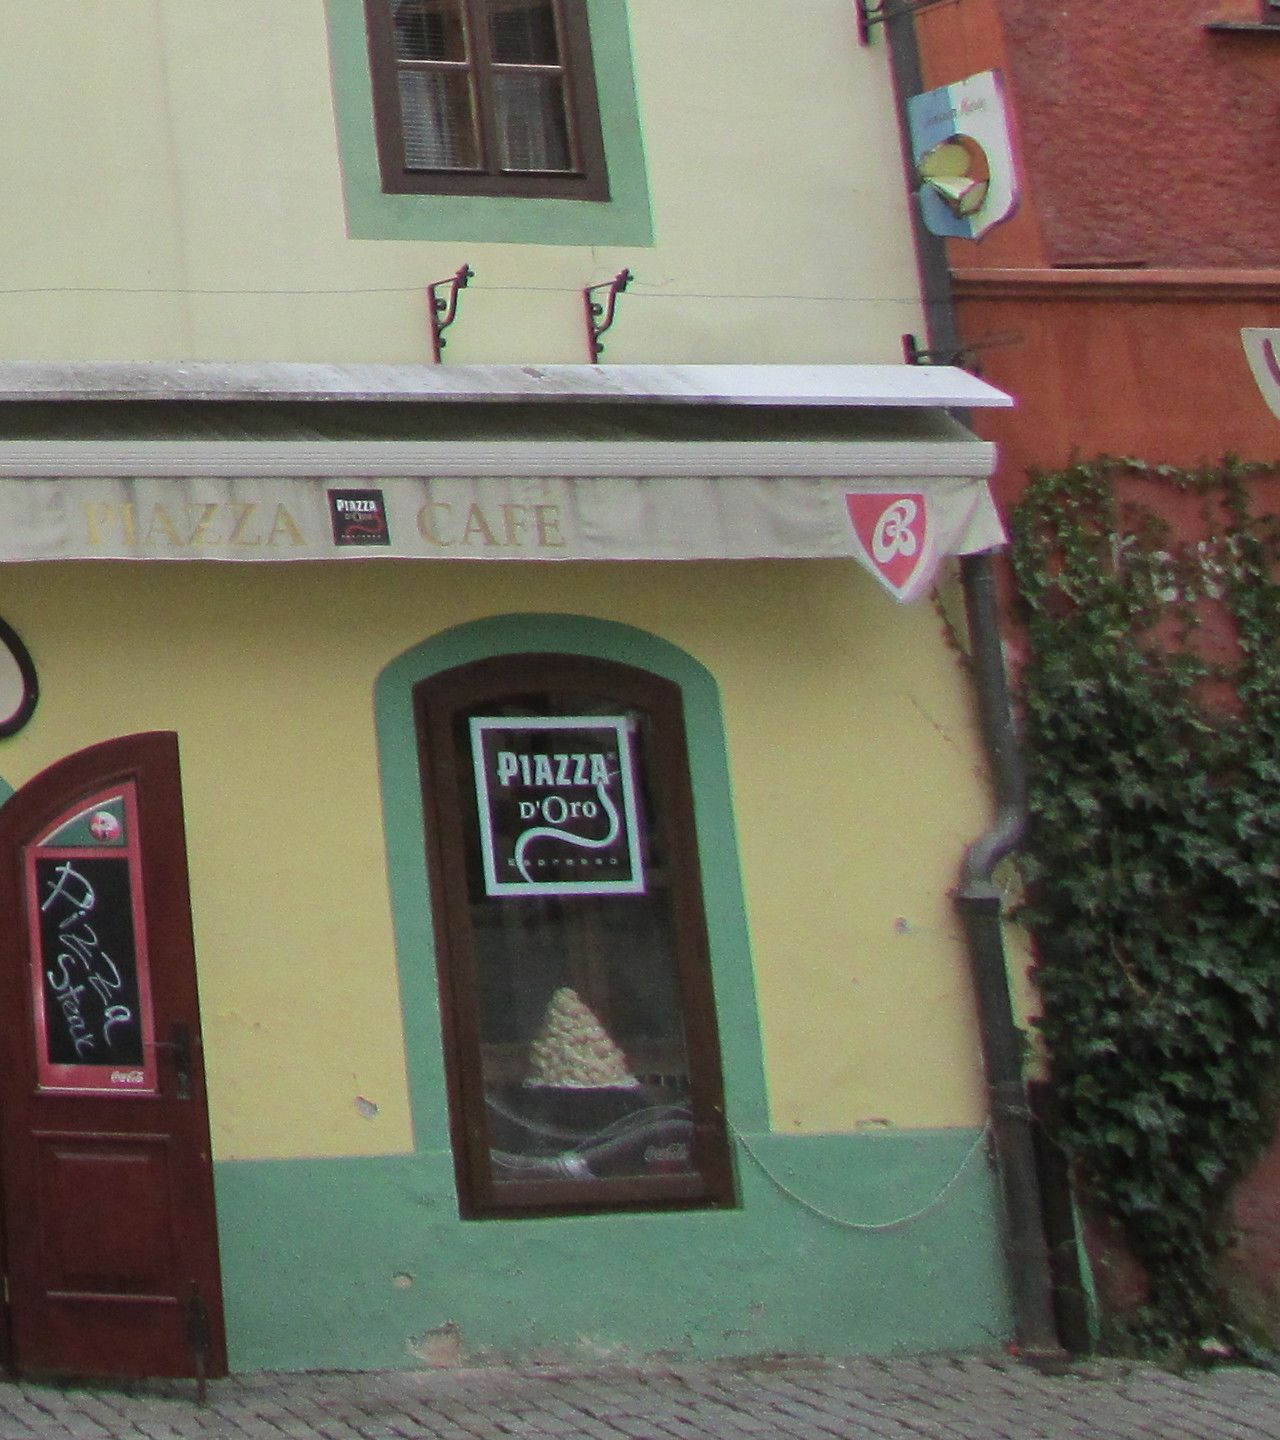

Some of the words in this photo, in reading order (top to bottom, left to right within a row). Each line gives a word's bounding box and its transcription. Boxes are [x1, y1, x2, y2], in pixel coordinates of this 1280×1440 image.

[336, 499, 377, 512] PIAZZA
[84, 501, 308, 546] PIAZZA
[497, 751, 610, 786] PIAZZA
[519, 796, 597, 824] D'Oro
[42, 861, 131, 1048] Pizza
